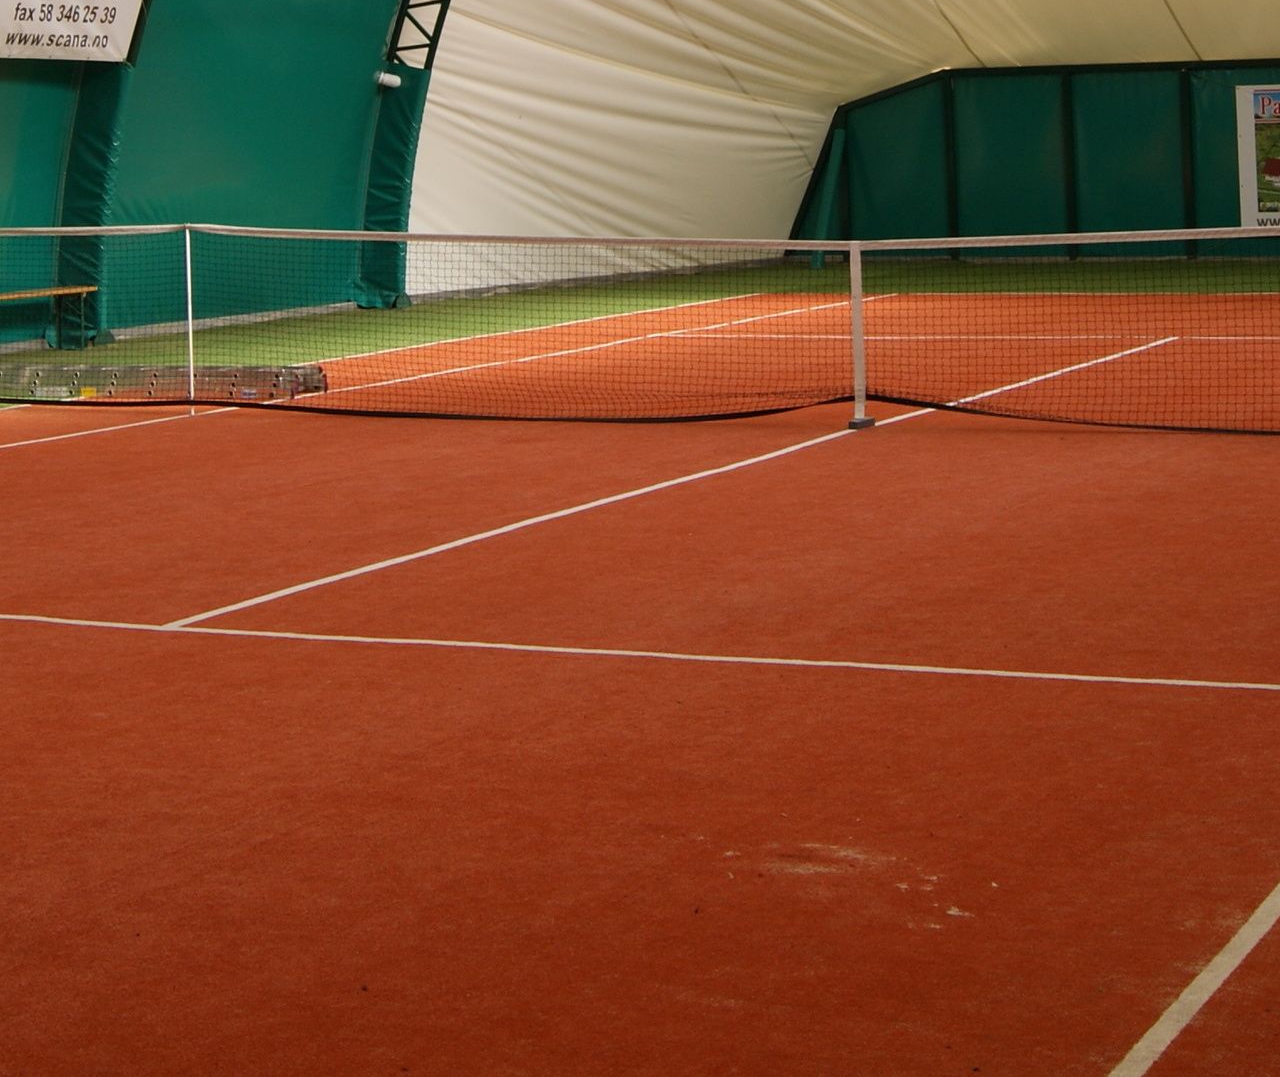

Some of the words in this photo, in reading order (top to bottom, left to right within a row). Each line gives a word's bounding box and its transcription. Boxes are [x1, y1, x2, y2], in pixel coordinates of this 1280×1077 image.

[13, 2, 34, 21] fax
[39, 3, 53, 22] 58
[56, 4, 79, 23] 346
[83, 6, 97, 23] 25
[100, 6, 117, 24] 39
[5, 31, 108, 48] www.scana.no
